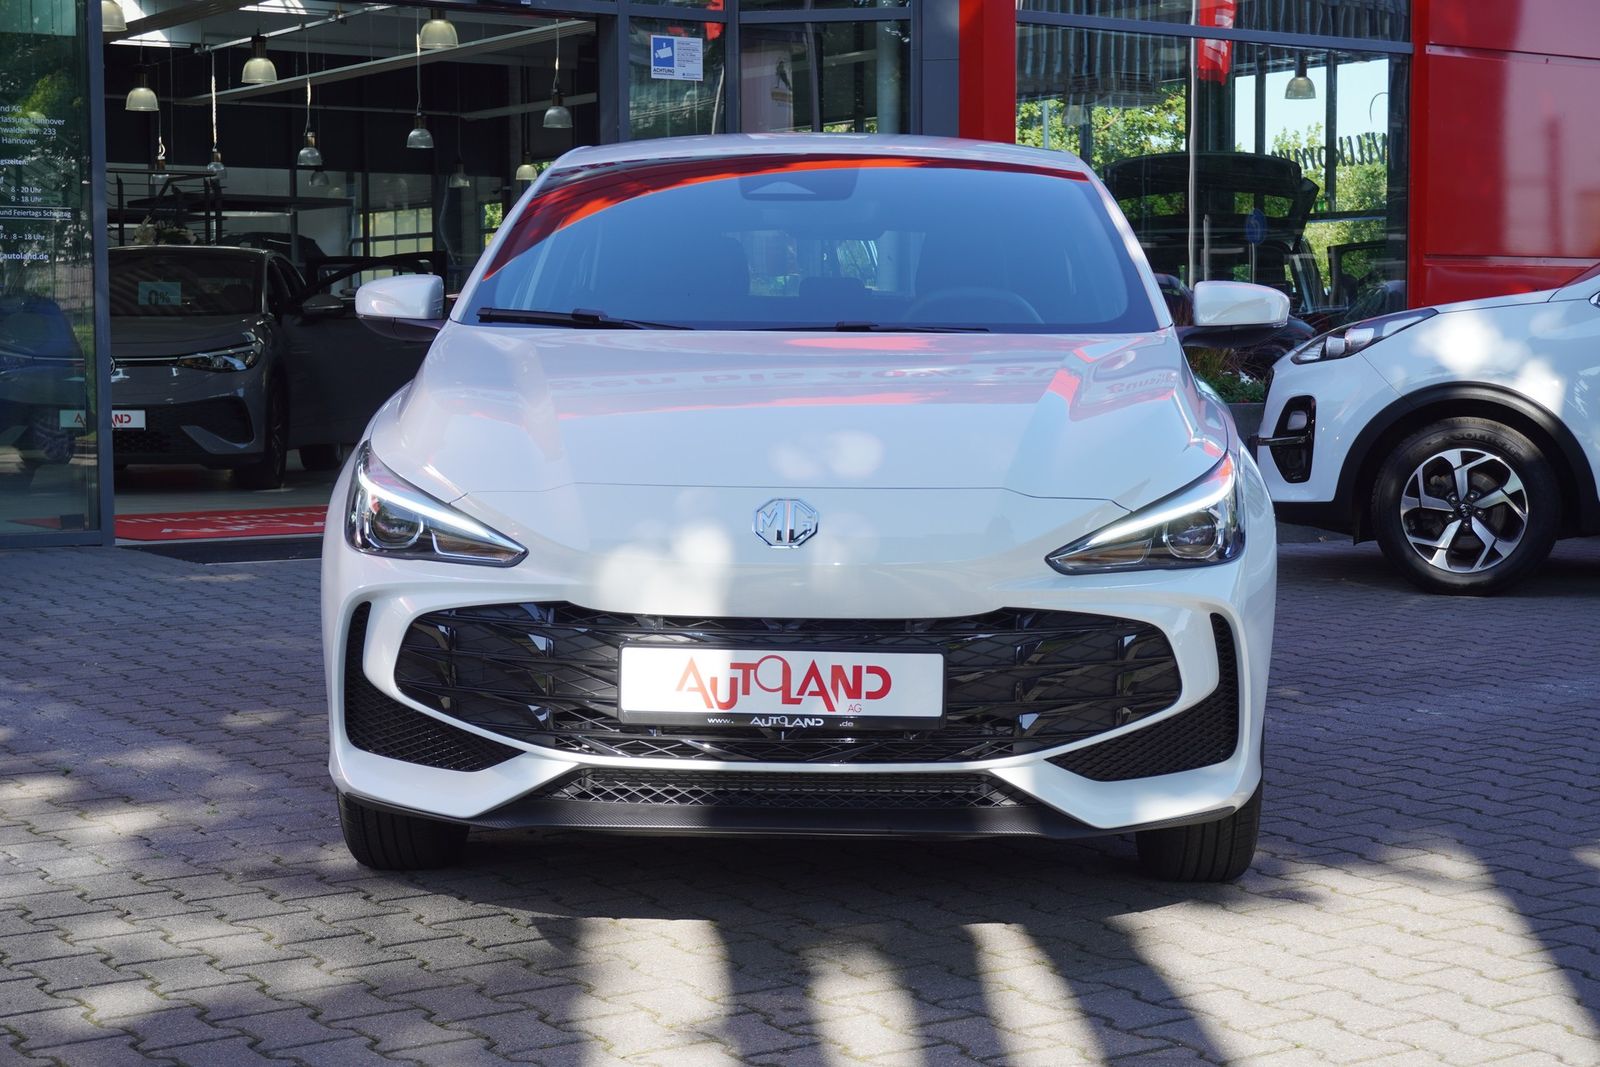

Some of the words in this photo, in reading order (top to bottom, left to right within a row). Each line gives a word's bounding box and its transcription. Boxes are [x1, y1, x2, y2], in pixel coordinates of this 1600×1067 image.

[11, 105, 22, 113] AG
[43, 127, 57, 136] 233
[1, 136, 37, 145] Hannover
[29, 186, 42, 194] Uhr
[29, 195, 42, 203] Uhr
[13, 209, 42, 218] Feiertags
[753, 499, 815, 546] MG
[675, 654, 892, 713] AUTOLAND
[847, 703, 863, 713] AG
[750, 716, 824, 728] AUTOLAND
